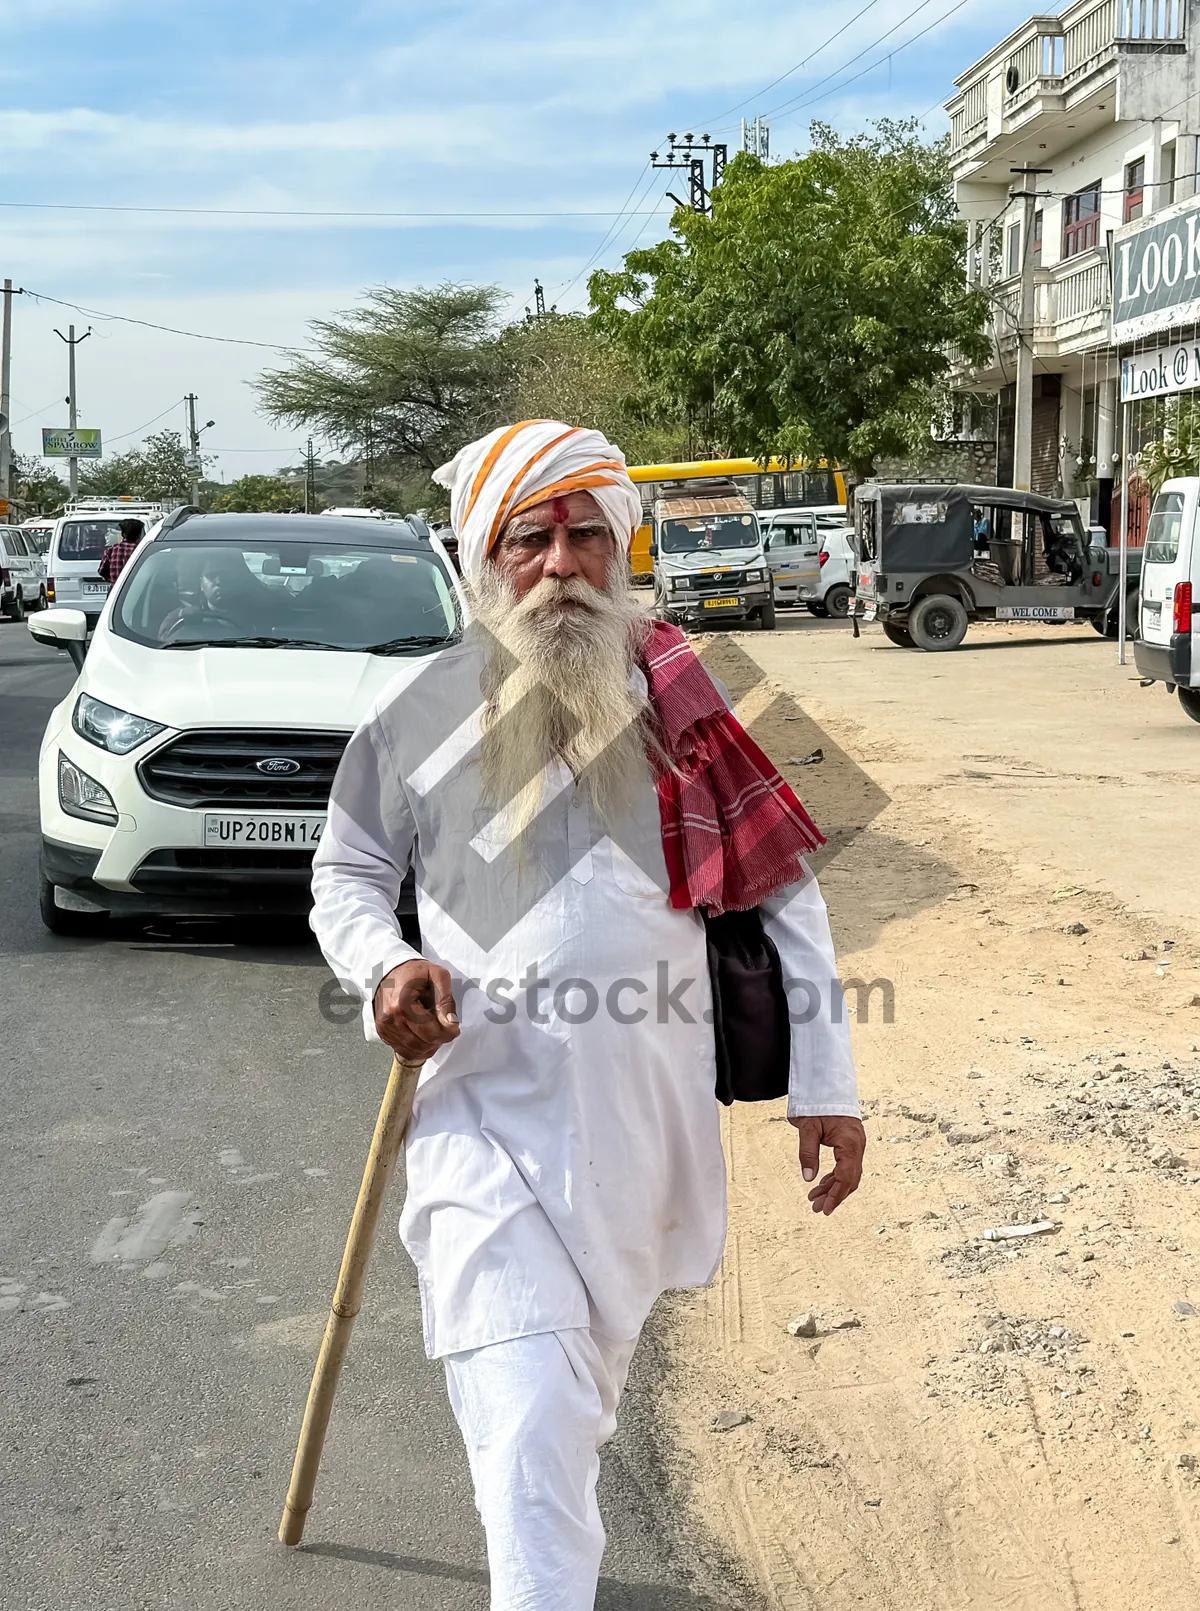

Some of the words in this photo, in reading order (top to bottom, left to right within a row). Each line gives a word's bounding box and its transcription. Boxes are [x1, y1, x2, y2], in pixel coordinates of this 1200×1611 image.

[1130, 353, 1168, 395] Look
[1173, 347, 1188, 385] @
[1012, 607, 1031, 617] WEL
[1032, 607, 1058, 617] COME
[266, 760, 290, 771] Ford
[219, 820, 321, 843] UP20BN14
